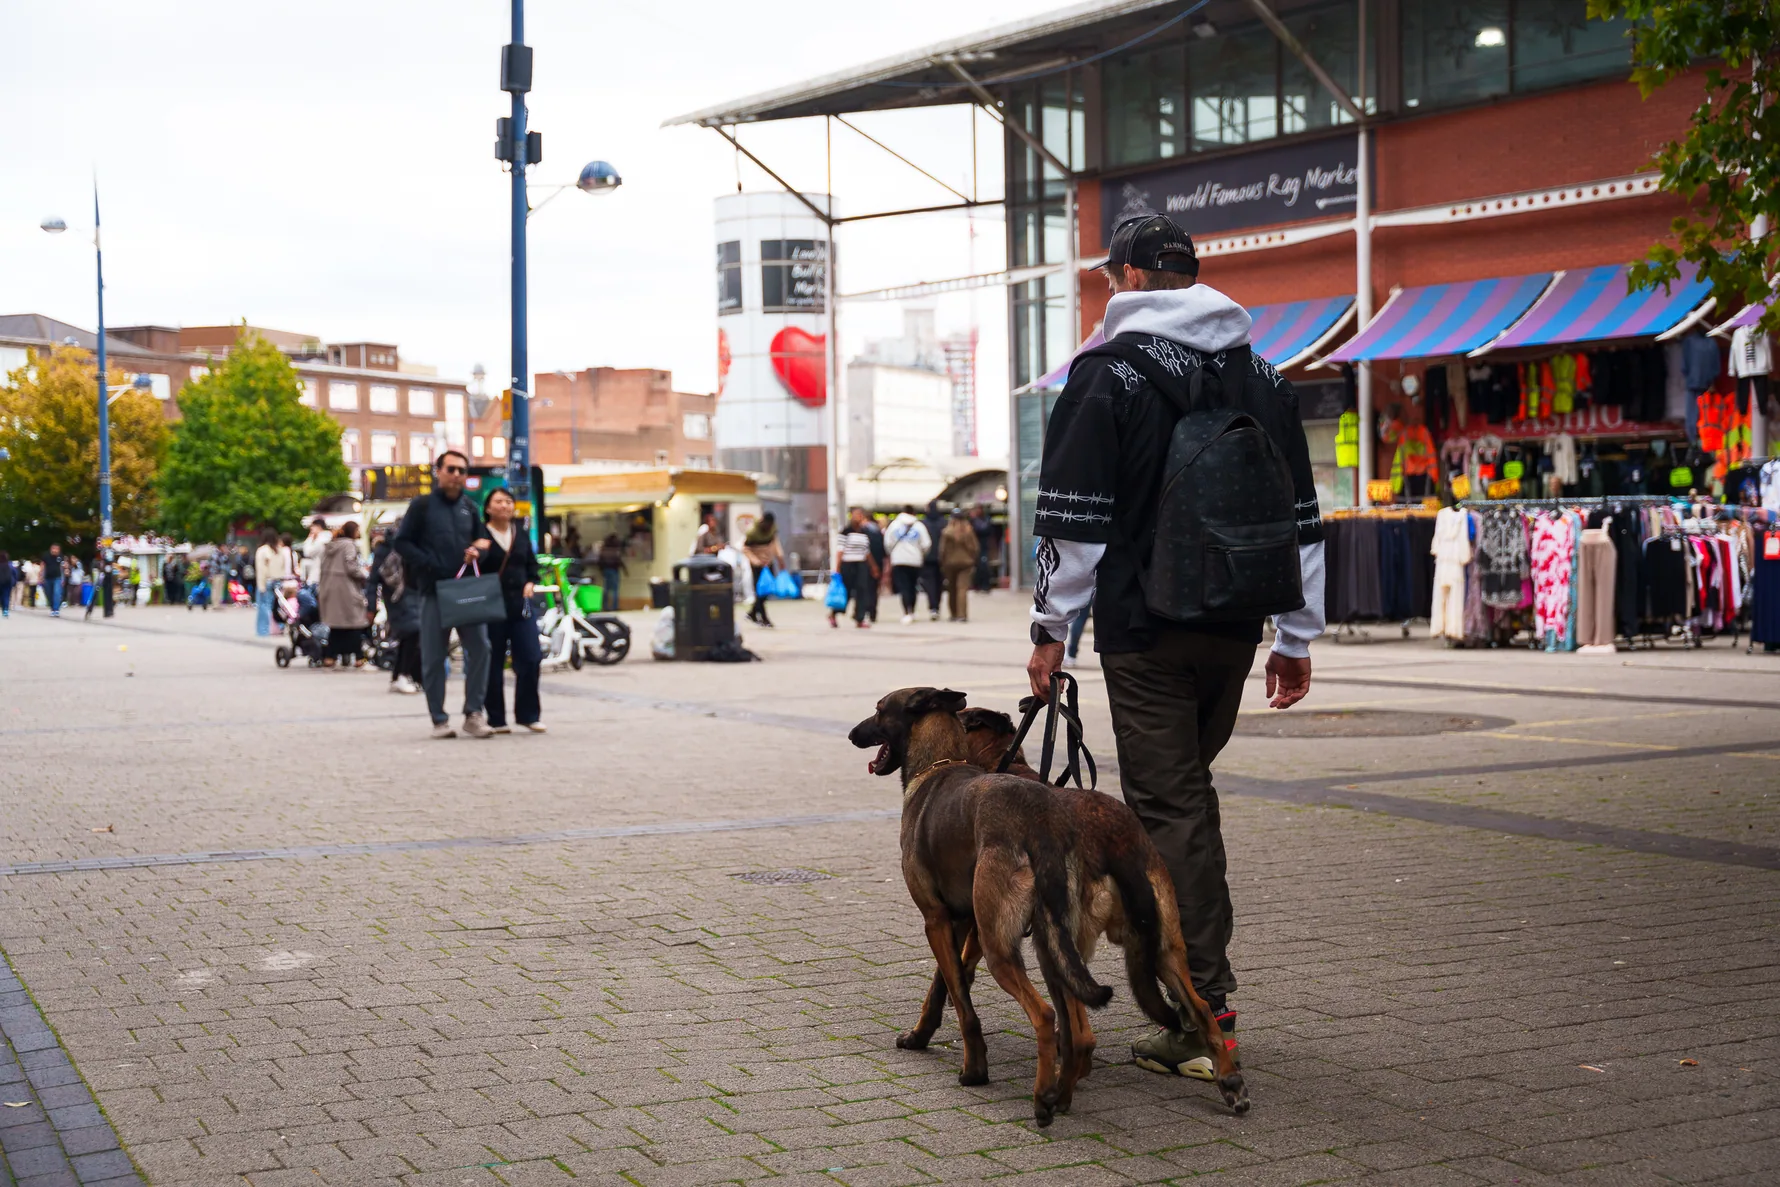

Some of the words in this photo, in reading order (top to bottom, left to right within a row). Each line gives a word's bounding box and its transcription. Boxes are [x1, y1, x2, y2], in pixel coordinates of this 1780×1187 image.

[1166, 180, 1213, 213] World
[1209, 181, 1265, 207] Famous
[1266, 172, 1301, 207] Rag
[1304, 161, 1357, 191] Marke
